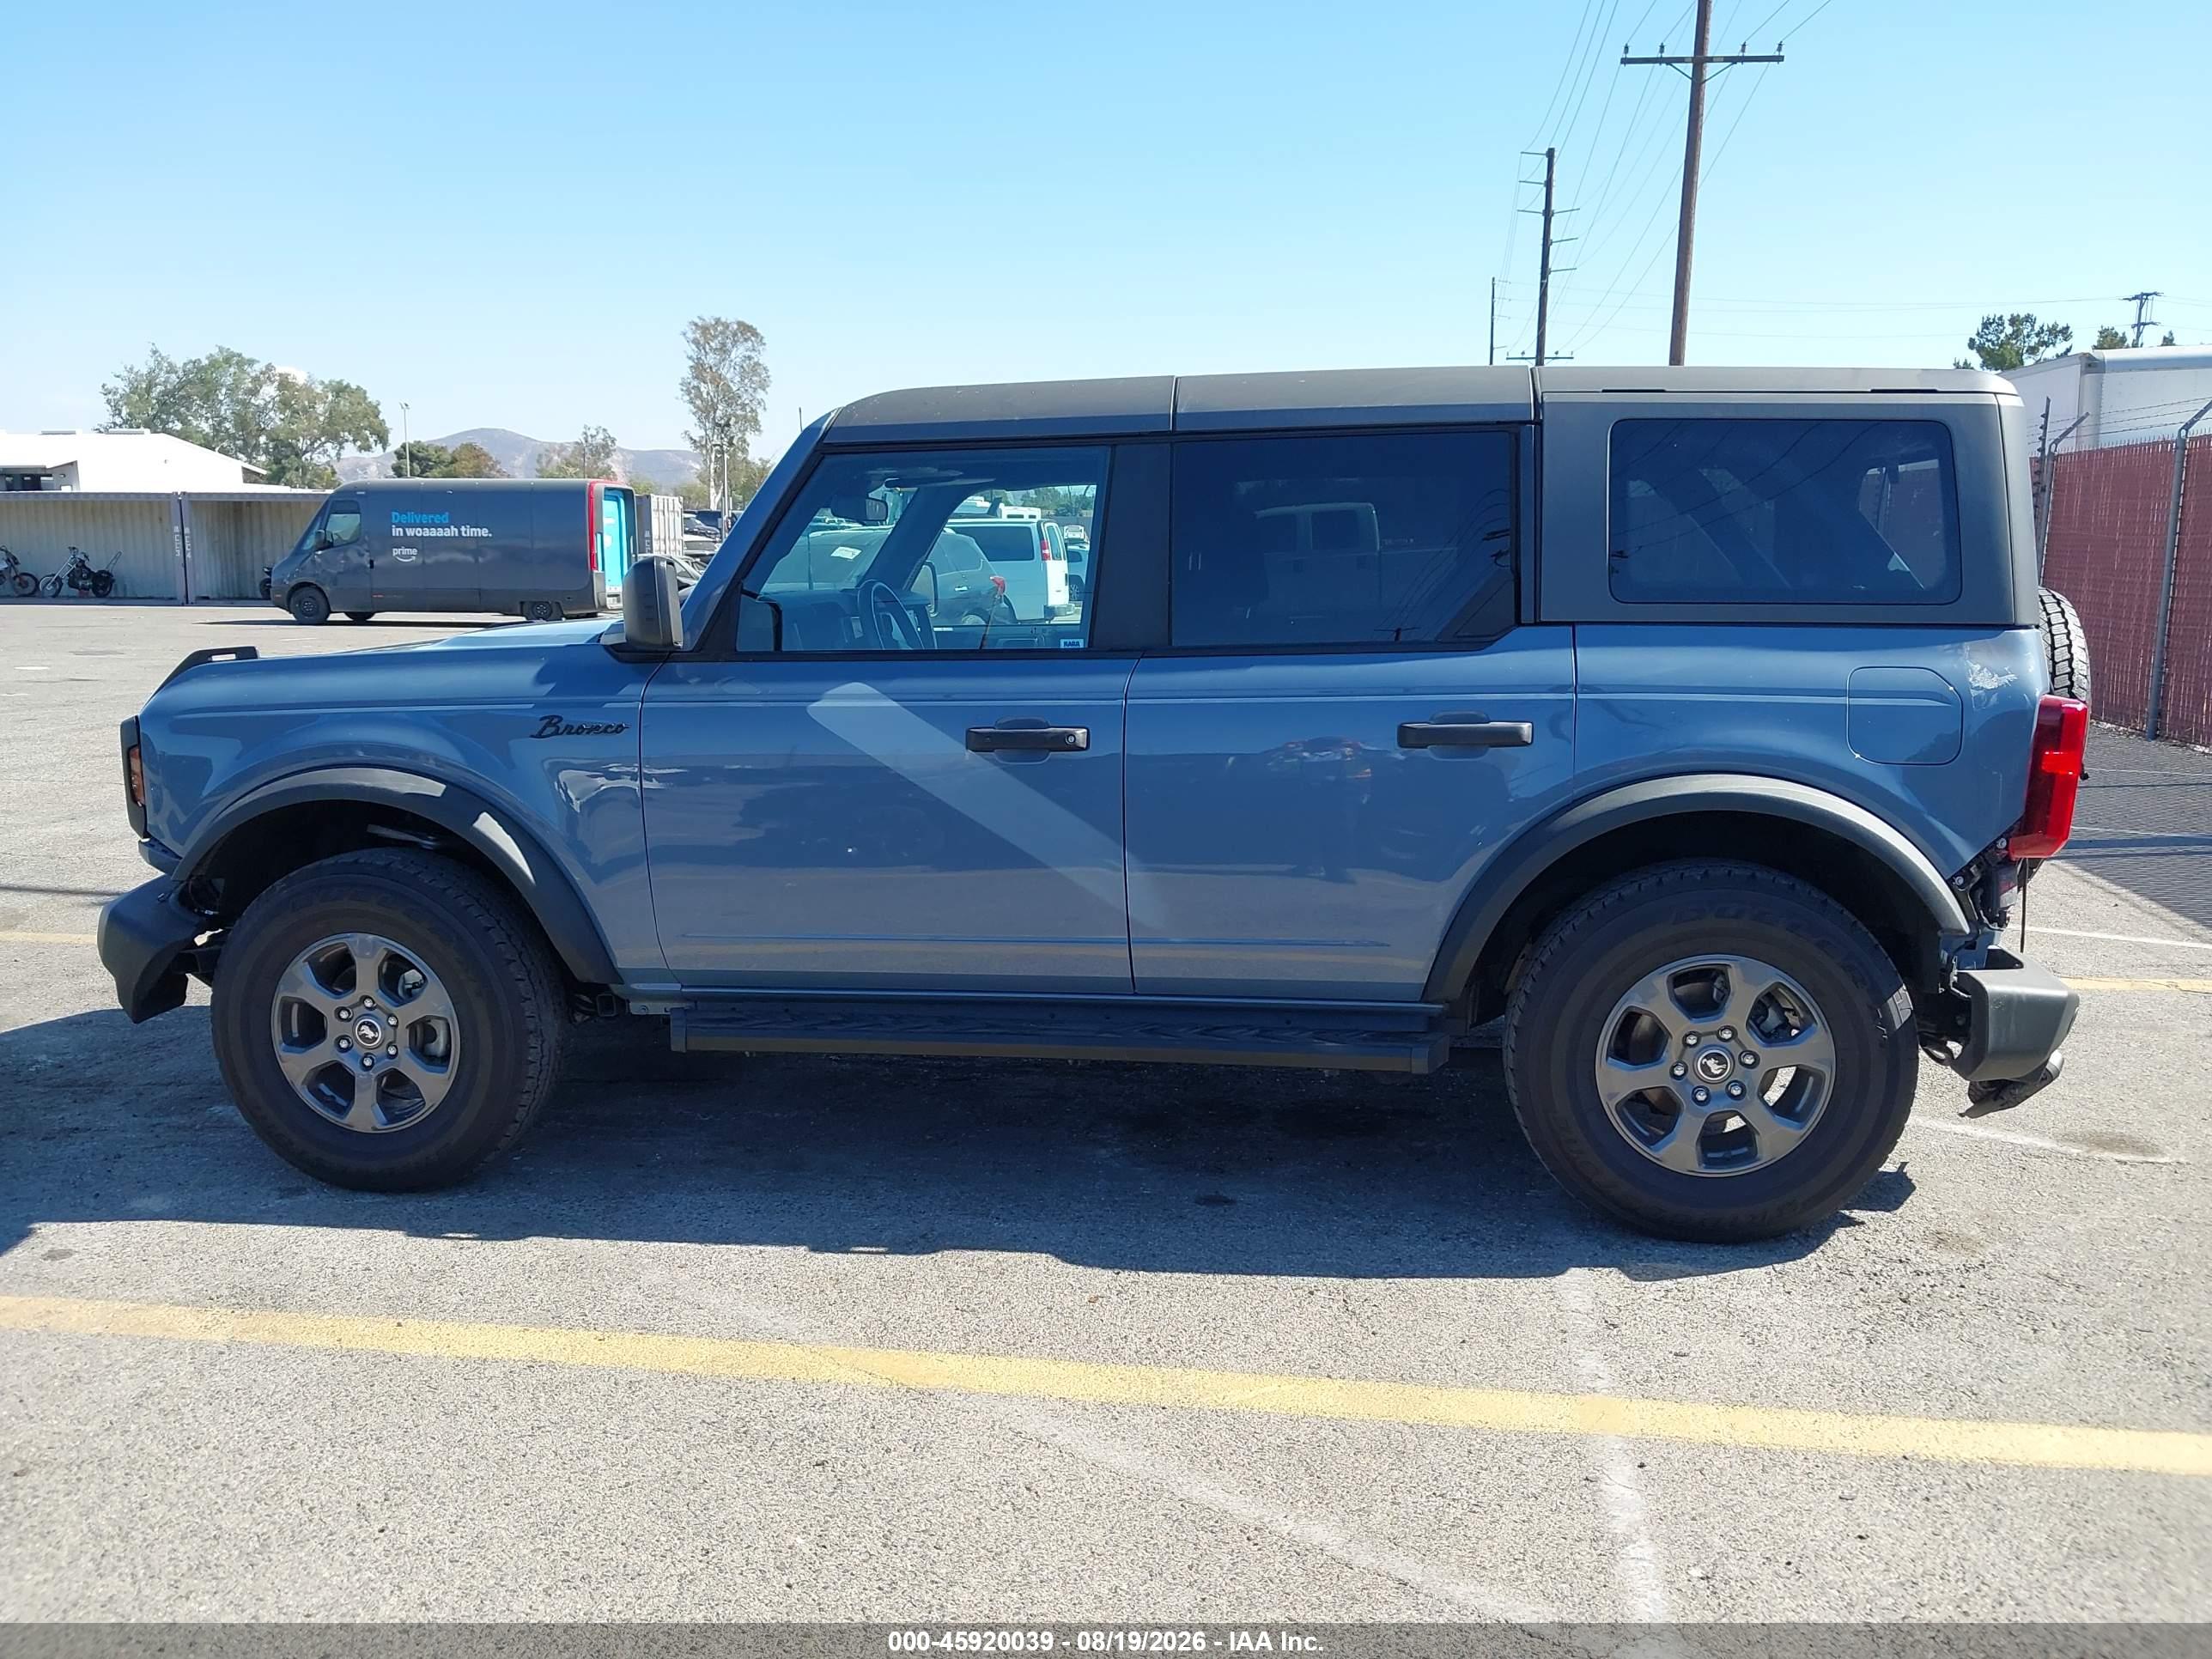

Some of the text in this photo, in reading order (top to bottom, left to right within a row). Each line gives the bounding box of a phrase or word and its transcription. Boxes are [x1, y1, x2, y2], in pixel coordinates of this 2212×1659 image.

[391, 512, 449, 524] Delivered
[392, 525, 492, 537] in woaaaah time.
[392, 546, 418, 556] prime
[529, 714, 631, 739] Bronco
